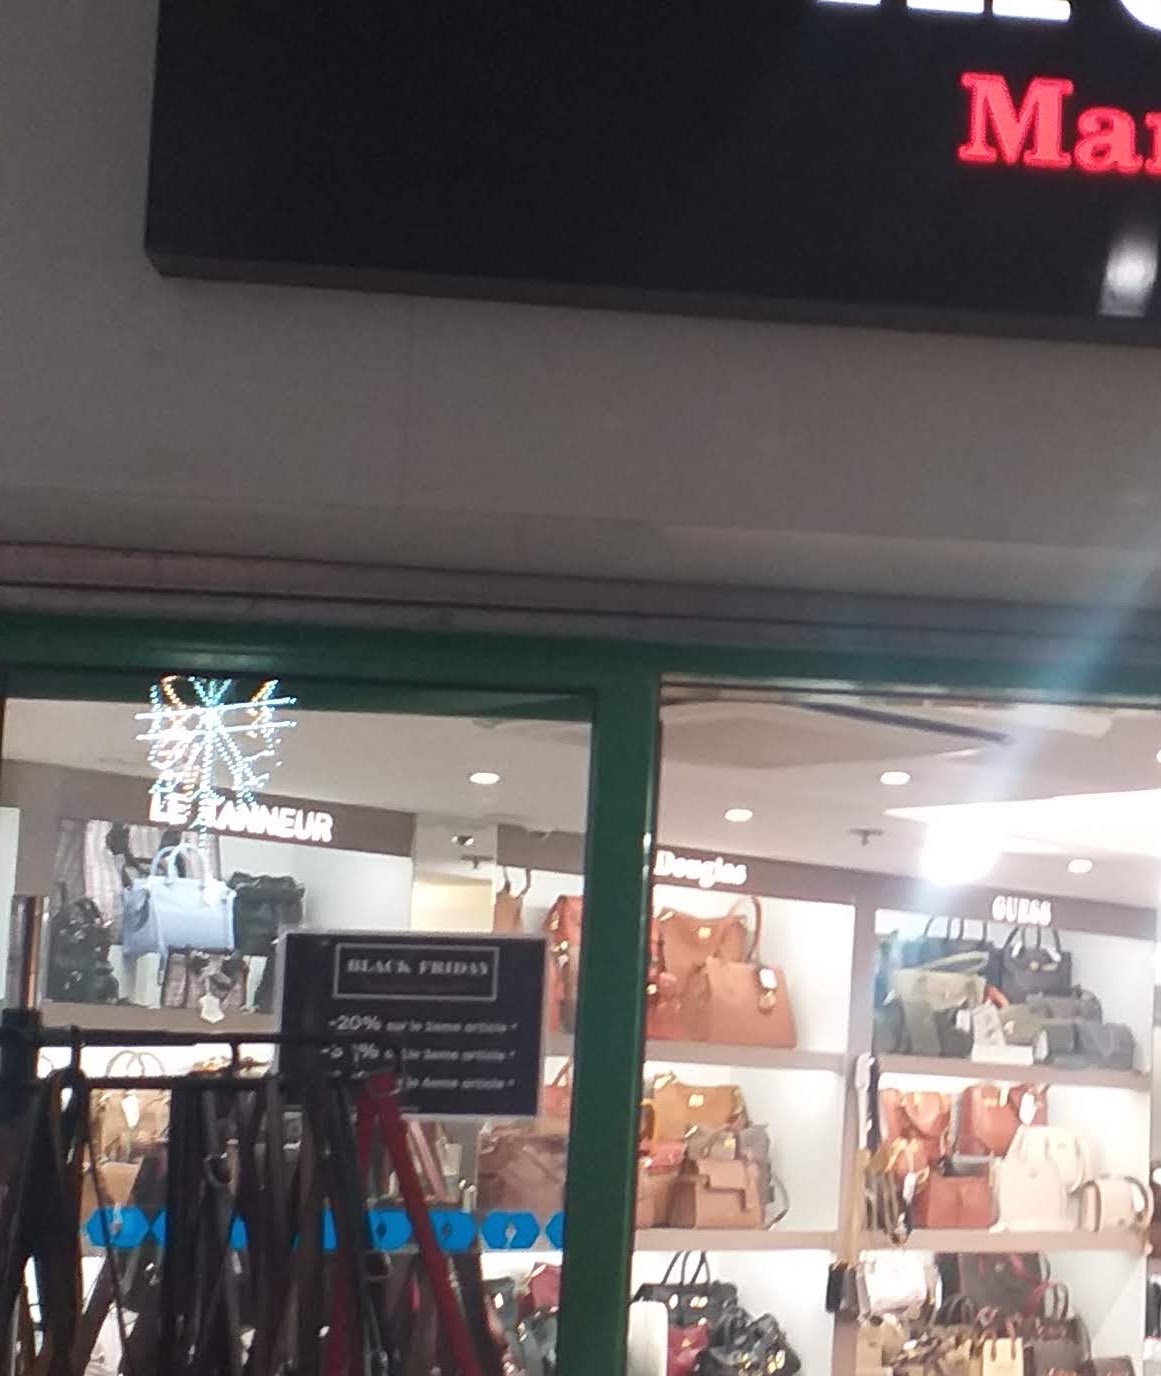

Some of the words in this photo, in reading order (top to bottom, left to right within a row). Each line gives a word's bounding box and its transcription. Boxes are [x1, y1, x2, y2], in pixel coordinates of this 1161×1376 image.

[347, 958, 410, 973] BLACK
[419, 960, 489, 976] FRIDAY
[329, 1015, 381, 1032] -20%
